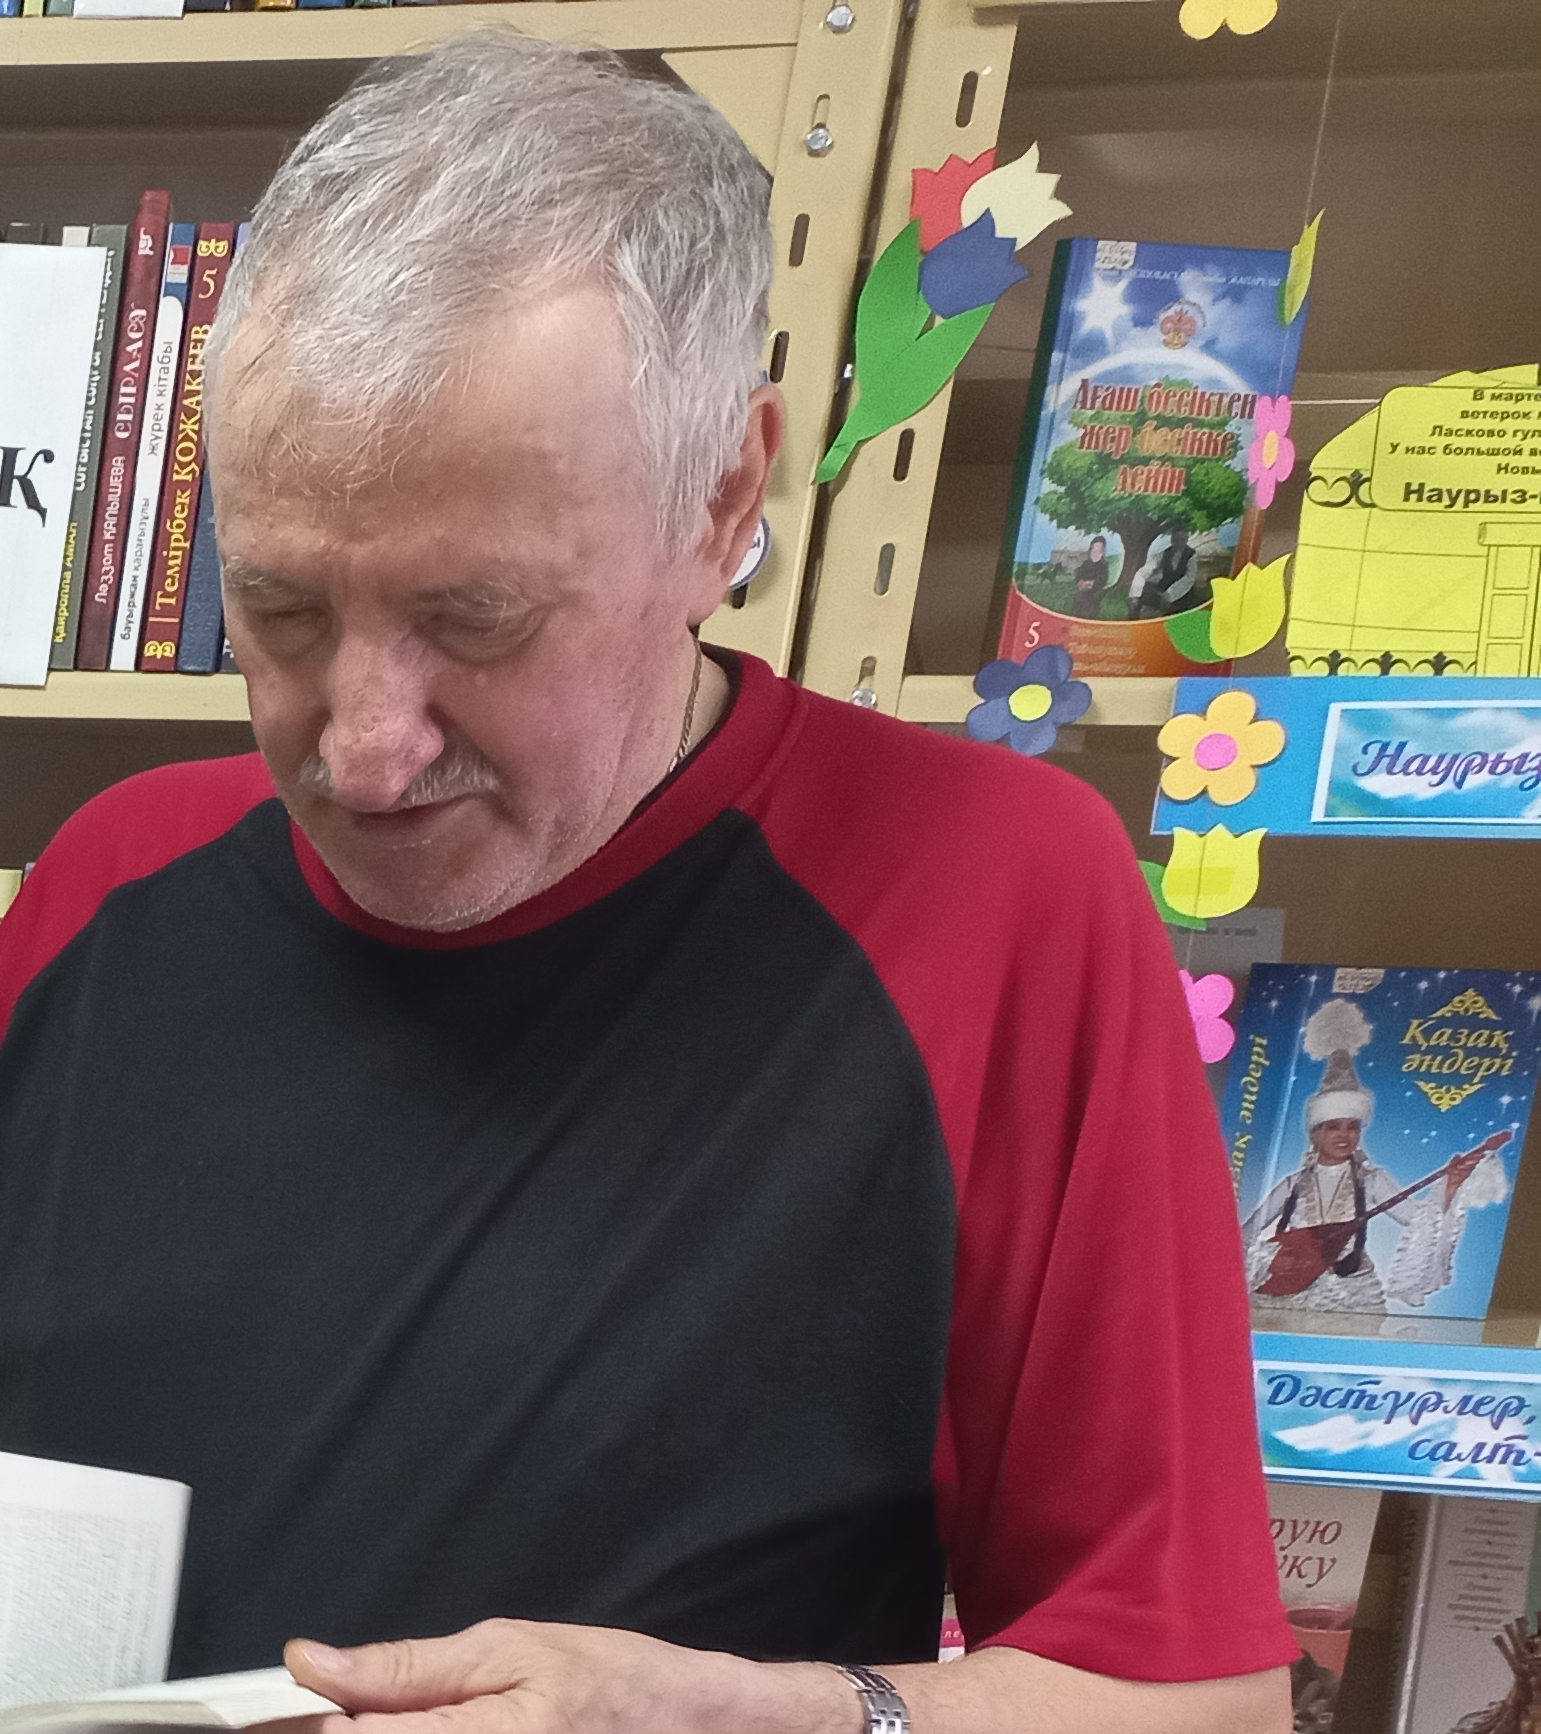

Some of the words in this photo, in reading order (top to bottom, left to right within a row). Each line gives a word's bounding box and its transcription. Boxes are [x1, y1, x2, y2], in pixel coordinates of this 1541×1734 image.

[198, 269, 217, 298] 5
[1073, 379, 1139, 417] Ағаш
[1147, 381, 1258, 421] бесіктен
[1460, 410, 1531, 422] ветерок
[1429, 426, 1506, 437] Ласково
[1389, 443, 1400, 454] У
[1405, 446, 1442, 455] нас
[1443, 443, 1523, 456] большой
[1024, 621, 1041, 648] 5
[1400, 1018, 1515, 1051] Қазақ
[1402, 1050, 1515, 1081] әндері
[1266, 1373, 1537, 1429] Дәстүрлер,
